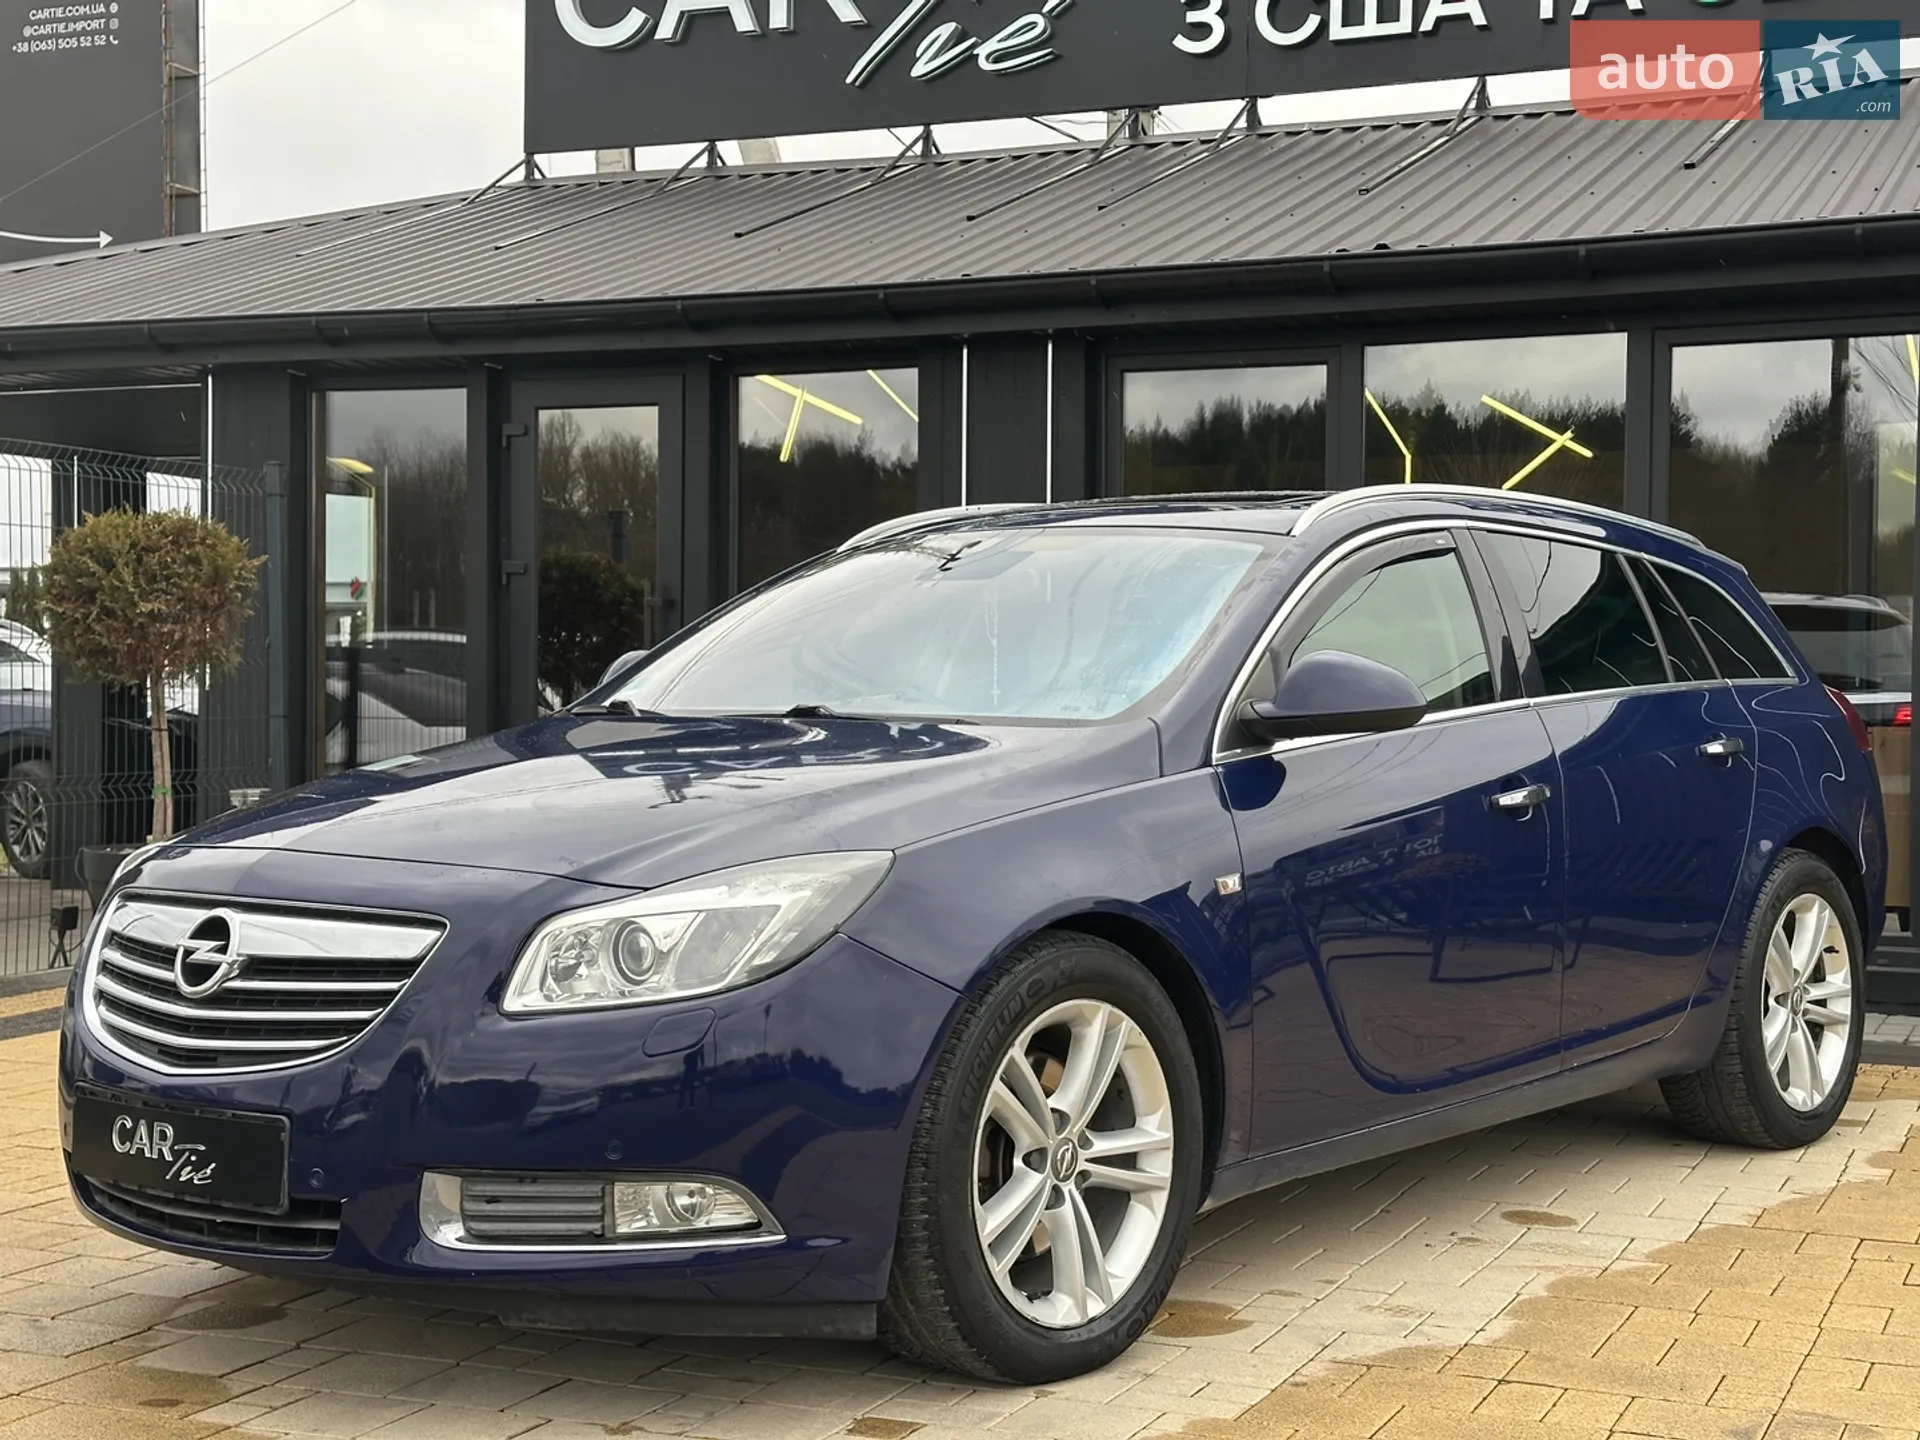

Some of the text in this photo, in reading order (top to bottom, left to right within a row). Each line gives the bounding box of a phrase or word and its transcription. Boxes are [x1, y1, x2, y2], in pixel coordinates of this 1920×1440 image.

[29, 3, 106, 20] CARTIE.COM.UA
[22, 18, 106, 37] @CARTIE.IMPORT
[12, 34, 107, 53] +38 (063) 505 52 52
[111, 1114, 174, 1162] CAR
